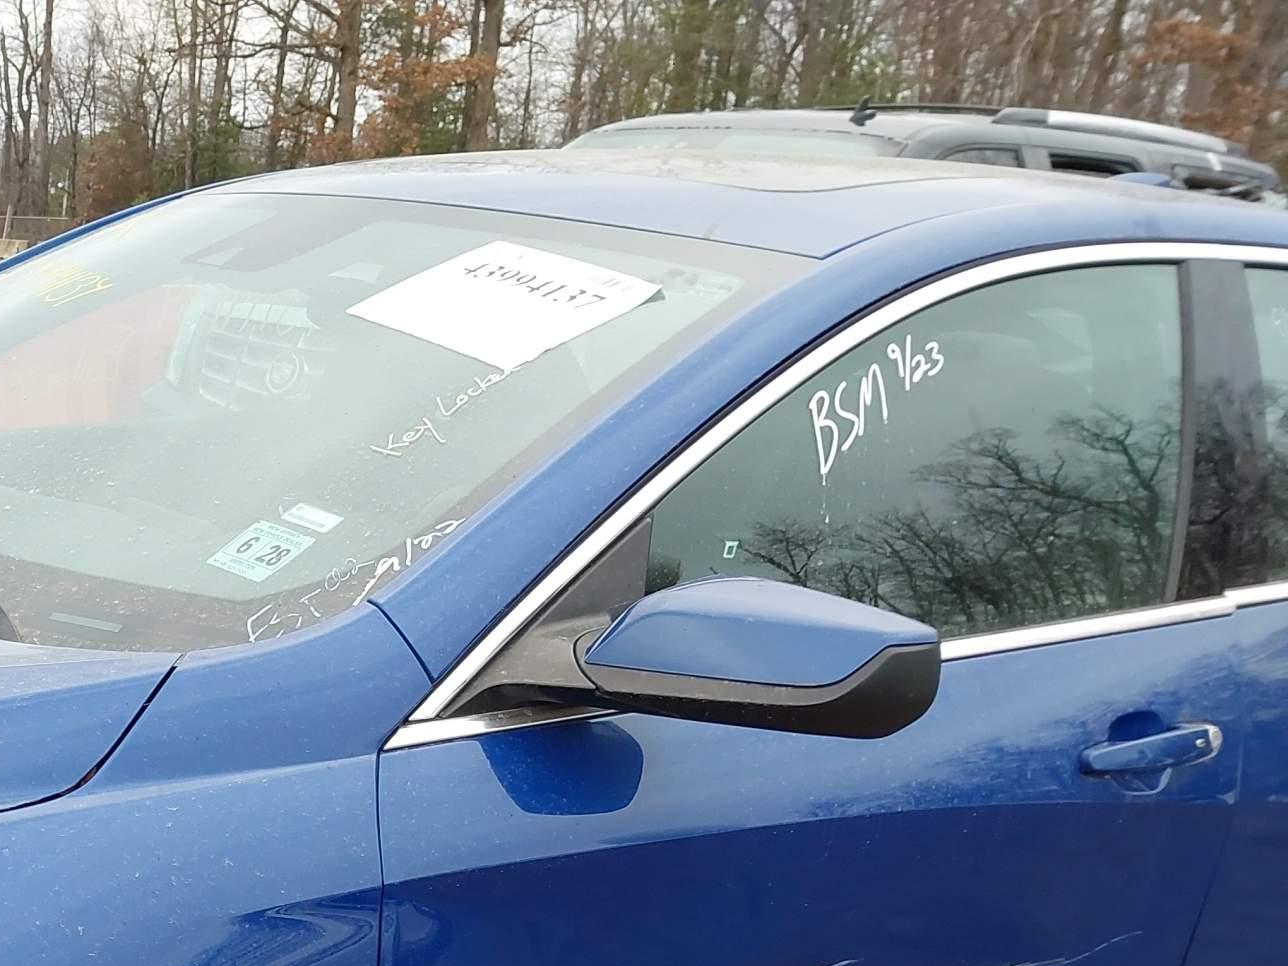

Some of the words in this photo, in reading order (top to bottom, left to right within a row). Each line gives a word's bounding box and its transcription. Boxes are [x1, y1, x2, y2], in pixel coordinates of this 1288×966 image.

[464, 262, 607, 309] 43994137
[809, 364, 888, 475] BSM
[886, 334, 944, 391] 9/23
[369, 417, 447, 456] Key
[236, 536, 261, 554] 6
[253, 544, 292, 567] 28
